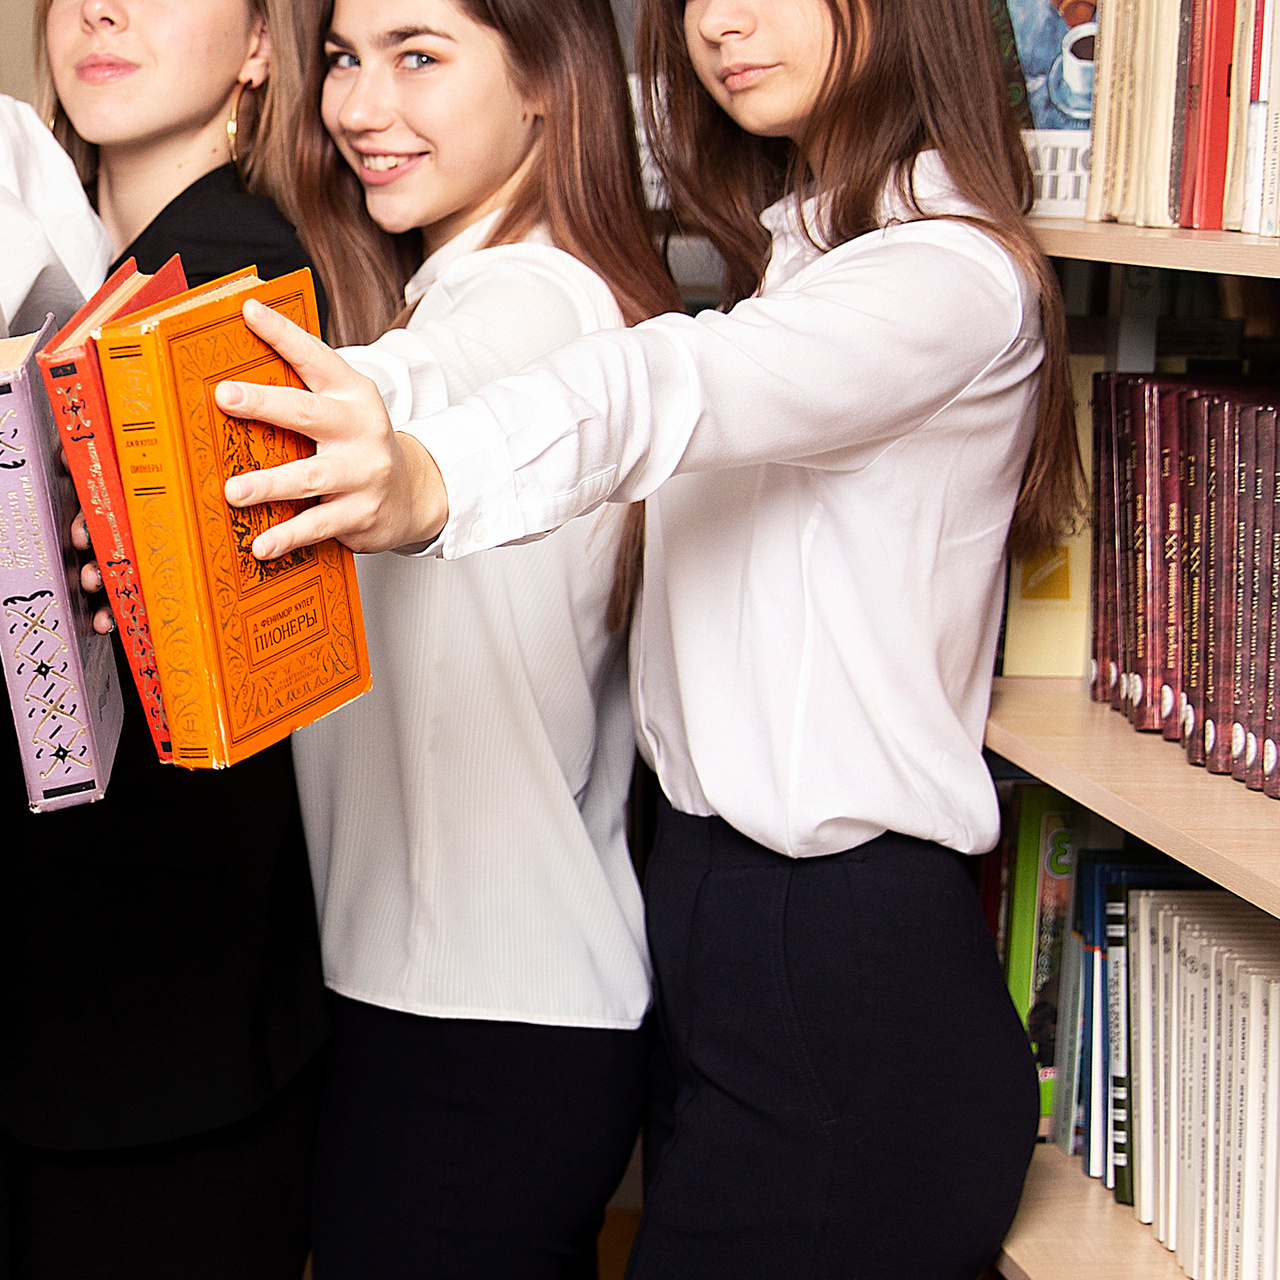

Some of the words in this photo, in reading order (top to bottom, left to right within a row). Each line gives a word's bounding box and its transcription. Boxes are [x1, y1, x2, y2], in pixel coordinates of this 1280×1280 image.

[1238, 471, 1247, 493] Том
[1254, 478, 1262, 500] Том
[1167, 502, 1177, 532] века
[1192, 514, 1201, 544] века
[1163, 534, 1177, 561] XX
[1190, 548, 1201, 574] XX
[1166, 563, 1177, 624] половины
[1271, 573, 1279, 599] для
[260, 606, 293, 628] ФЕНИМОР
[294, 595, 315, 611] КУПЕР
[1192, 577, 1200, 640] половины
[254, 608, 318, 653] ПИОНЕРЫ
[1269, 600, 1278, 662] писатели
[1166, 626, 1178, 669] второй
[1191, 642, 1200, 688] второй
